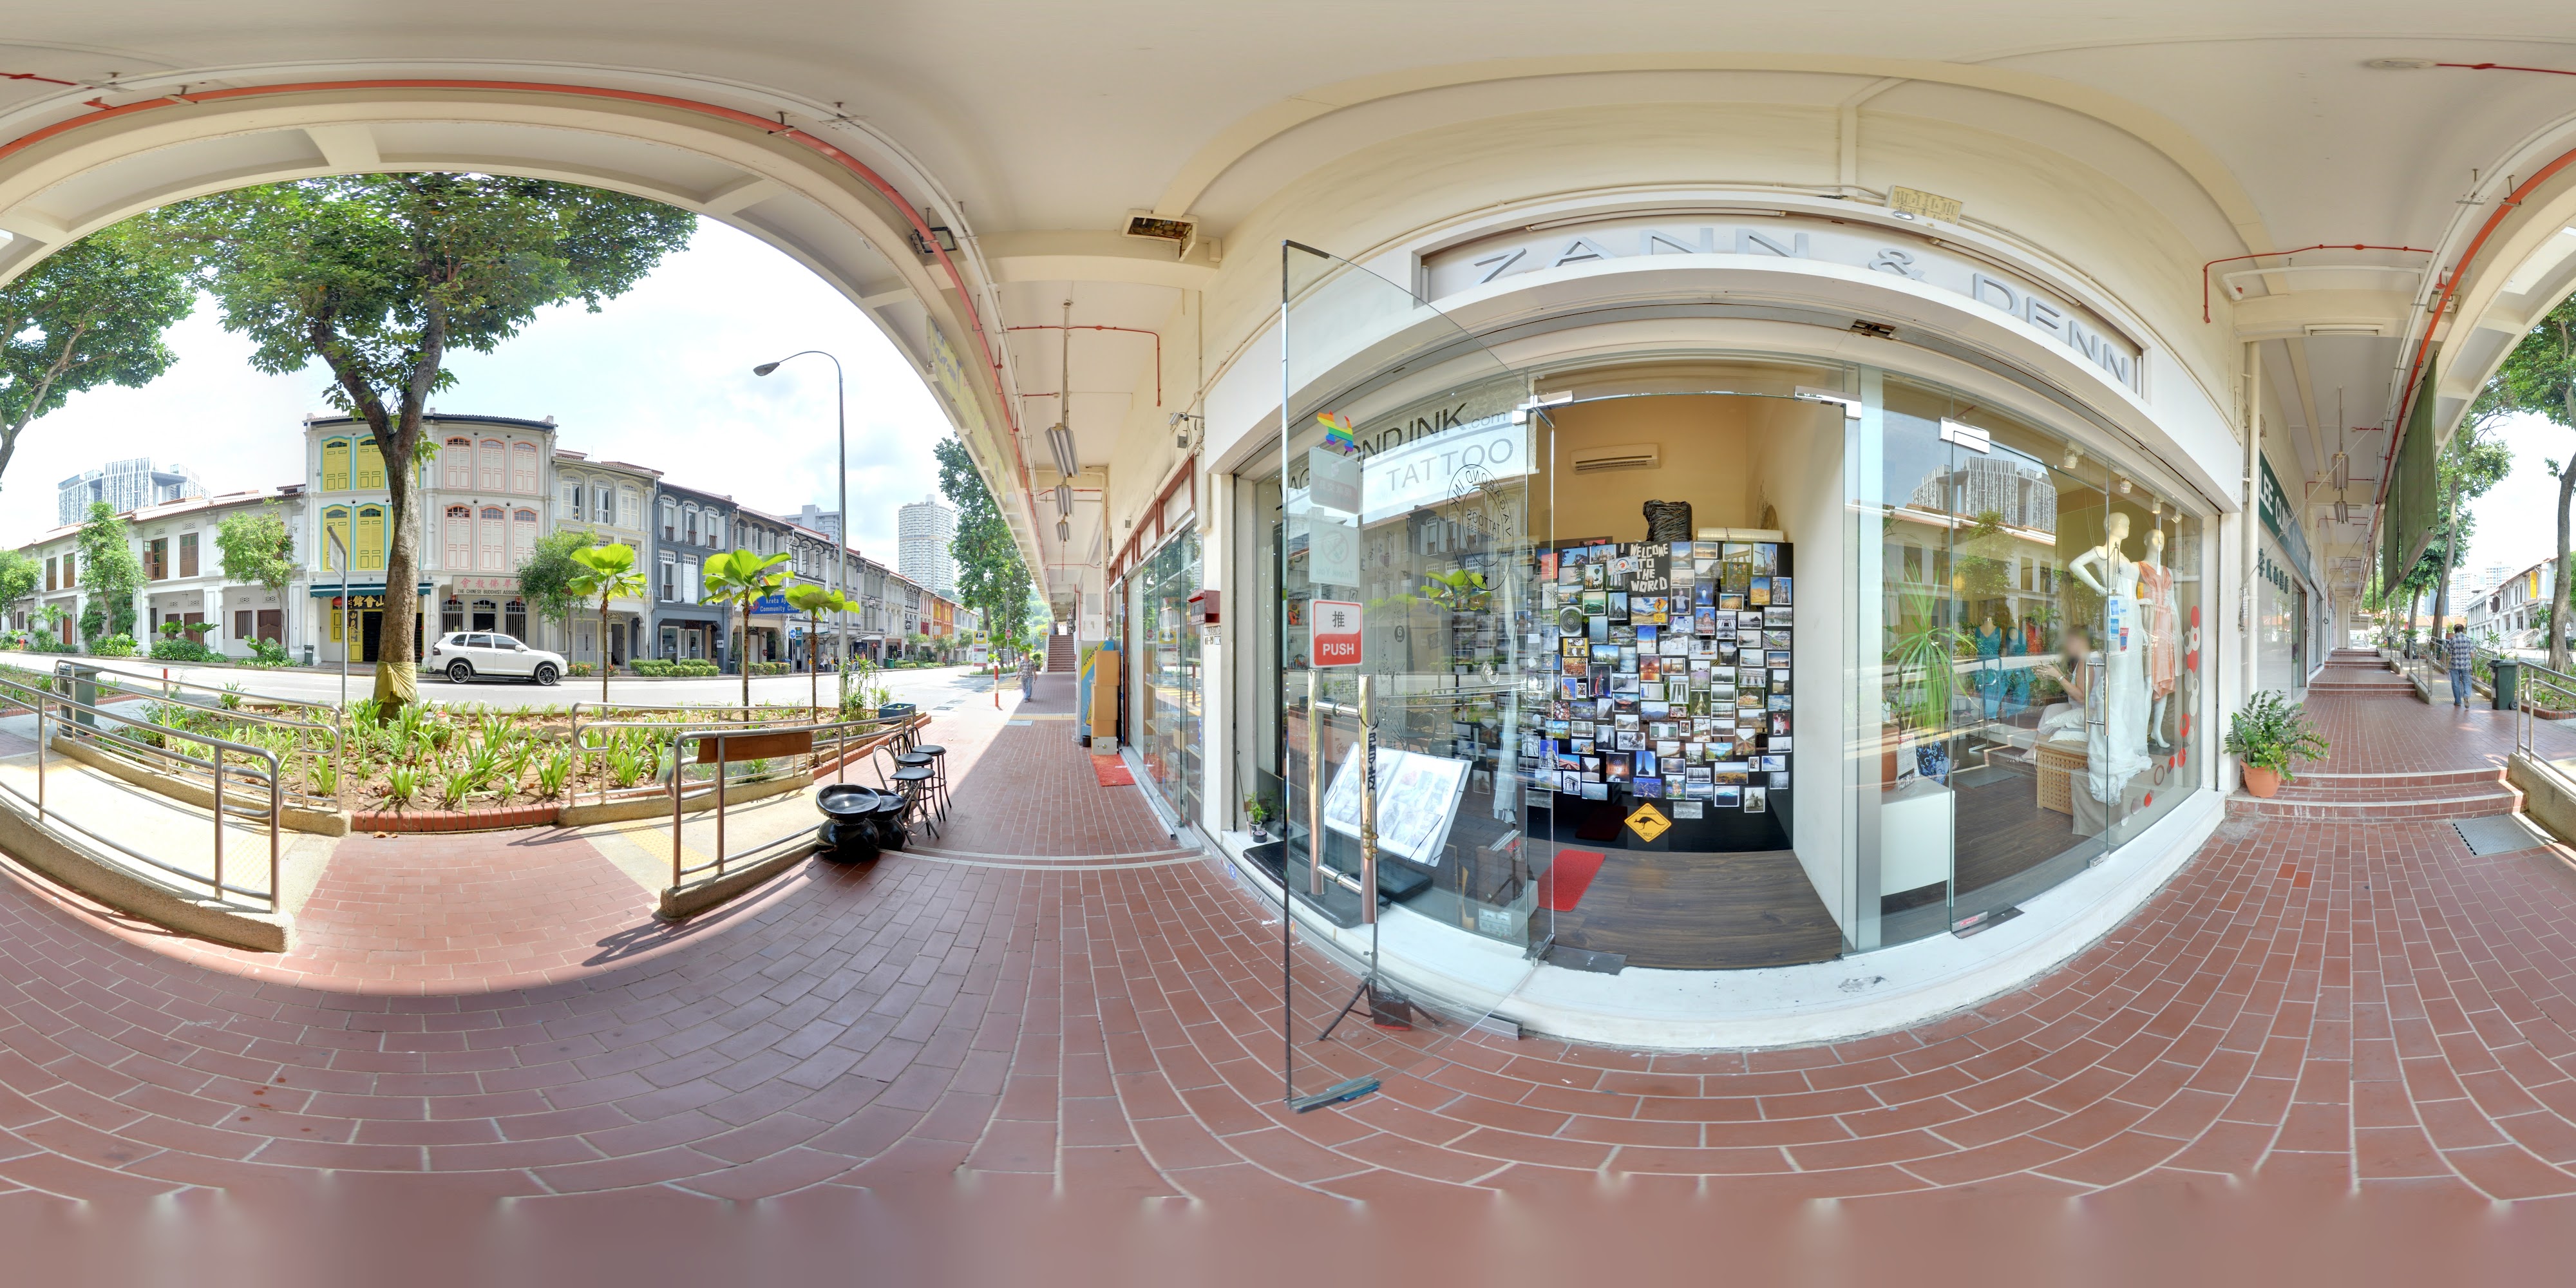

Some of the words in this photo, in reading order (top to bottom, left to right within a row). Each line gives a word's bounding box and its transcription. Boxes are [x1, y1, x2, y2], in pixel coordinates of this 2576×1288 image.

[1471, 227, 1809, 287] ZANN
[1868, 247, 1929, 283] &
[1972, 272, 2128, 386] DENN
[1386, 438, 1513, 491] TATTOO
[2259, 466, 2274, 516] LEE
[1630, 543, 1669, 558] WELCOME
[1638, 558, 1654, 568] TO
[1636, 569, 1656, 580] THE
[1630, 576, 1668, 593] WORLD
[1332, 611, 1345, 628] 推
[1397, 627, 1403, 636] 6
[1323, 643, 1354, 656] PUSH
